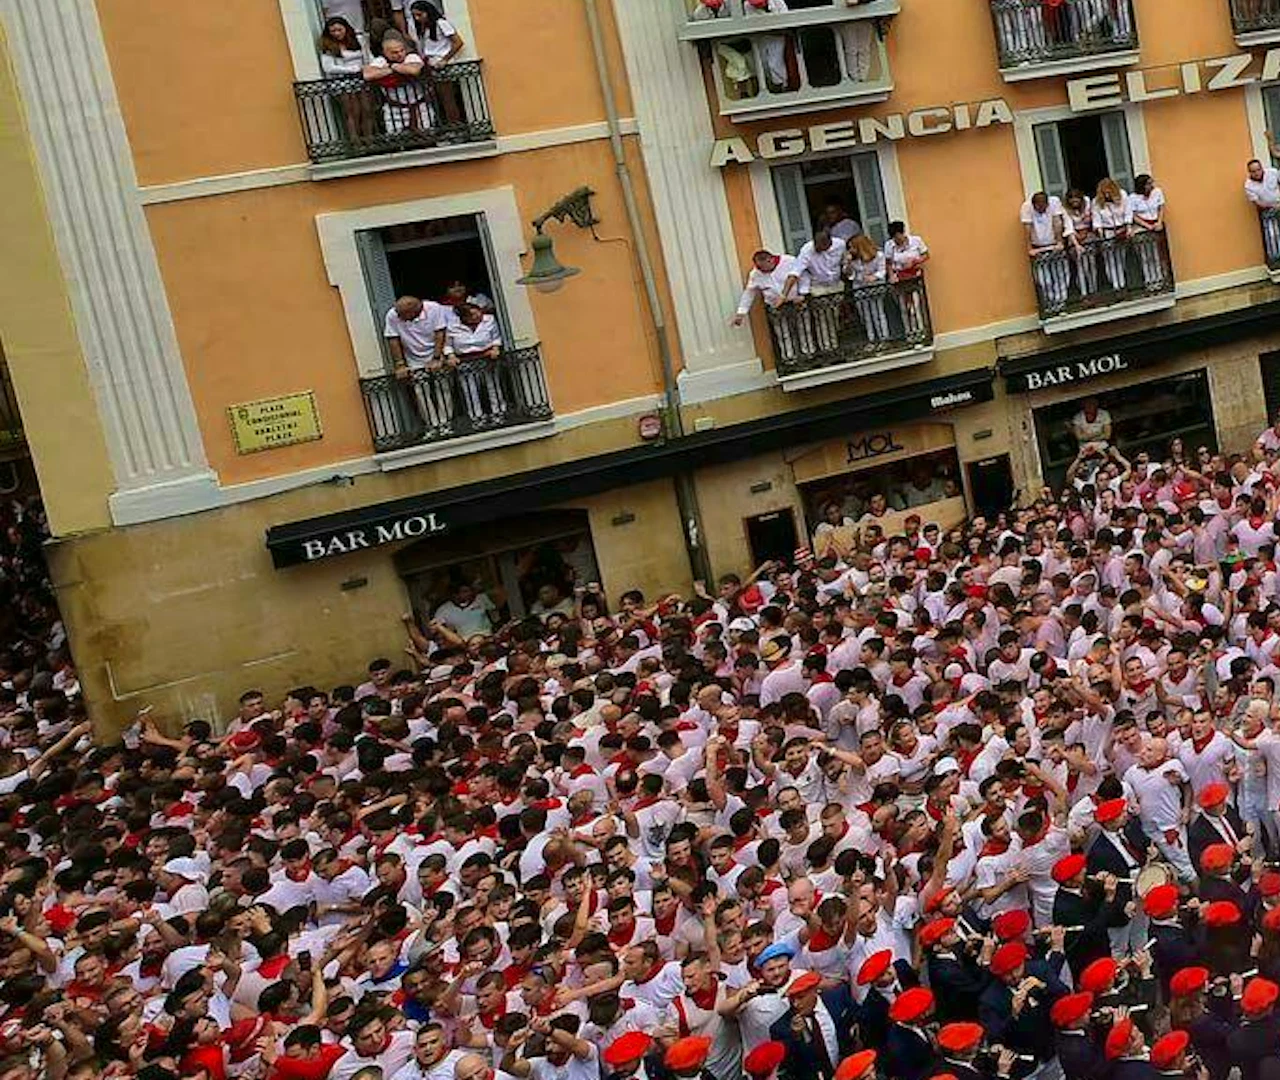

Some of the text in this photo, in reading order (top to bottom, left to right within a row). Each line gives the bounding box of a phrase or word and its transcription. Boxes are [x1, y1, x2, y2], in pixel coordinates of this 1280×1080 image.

[710, 98, 1016, 167] AGENCIA
[1025, 354, 1128, 390] BAR MOL
[847, 431, 904, 463] MOL
[302, 513, 446, 560] BAR MOL
